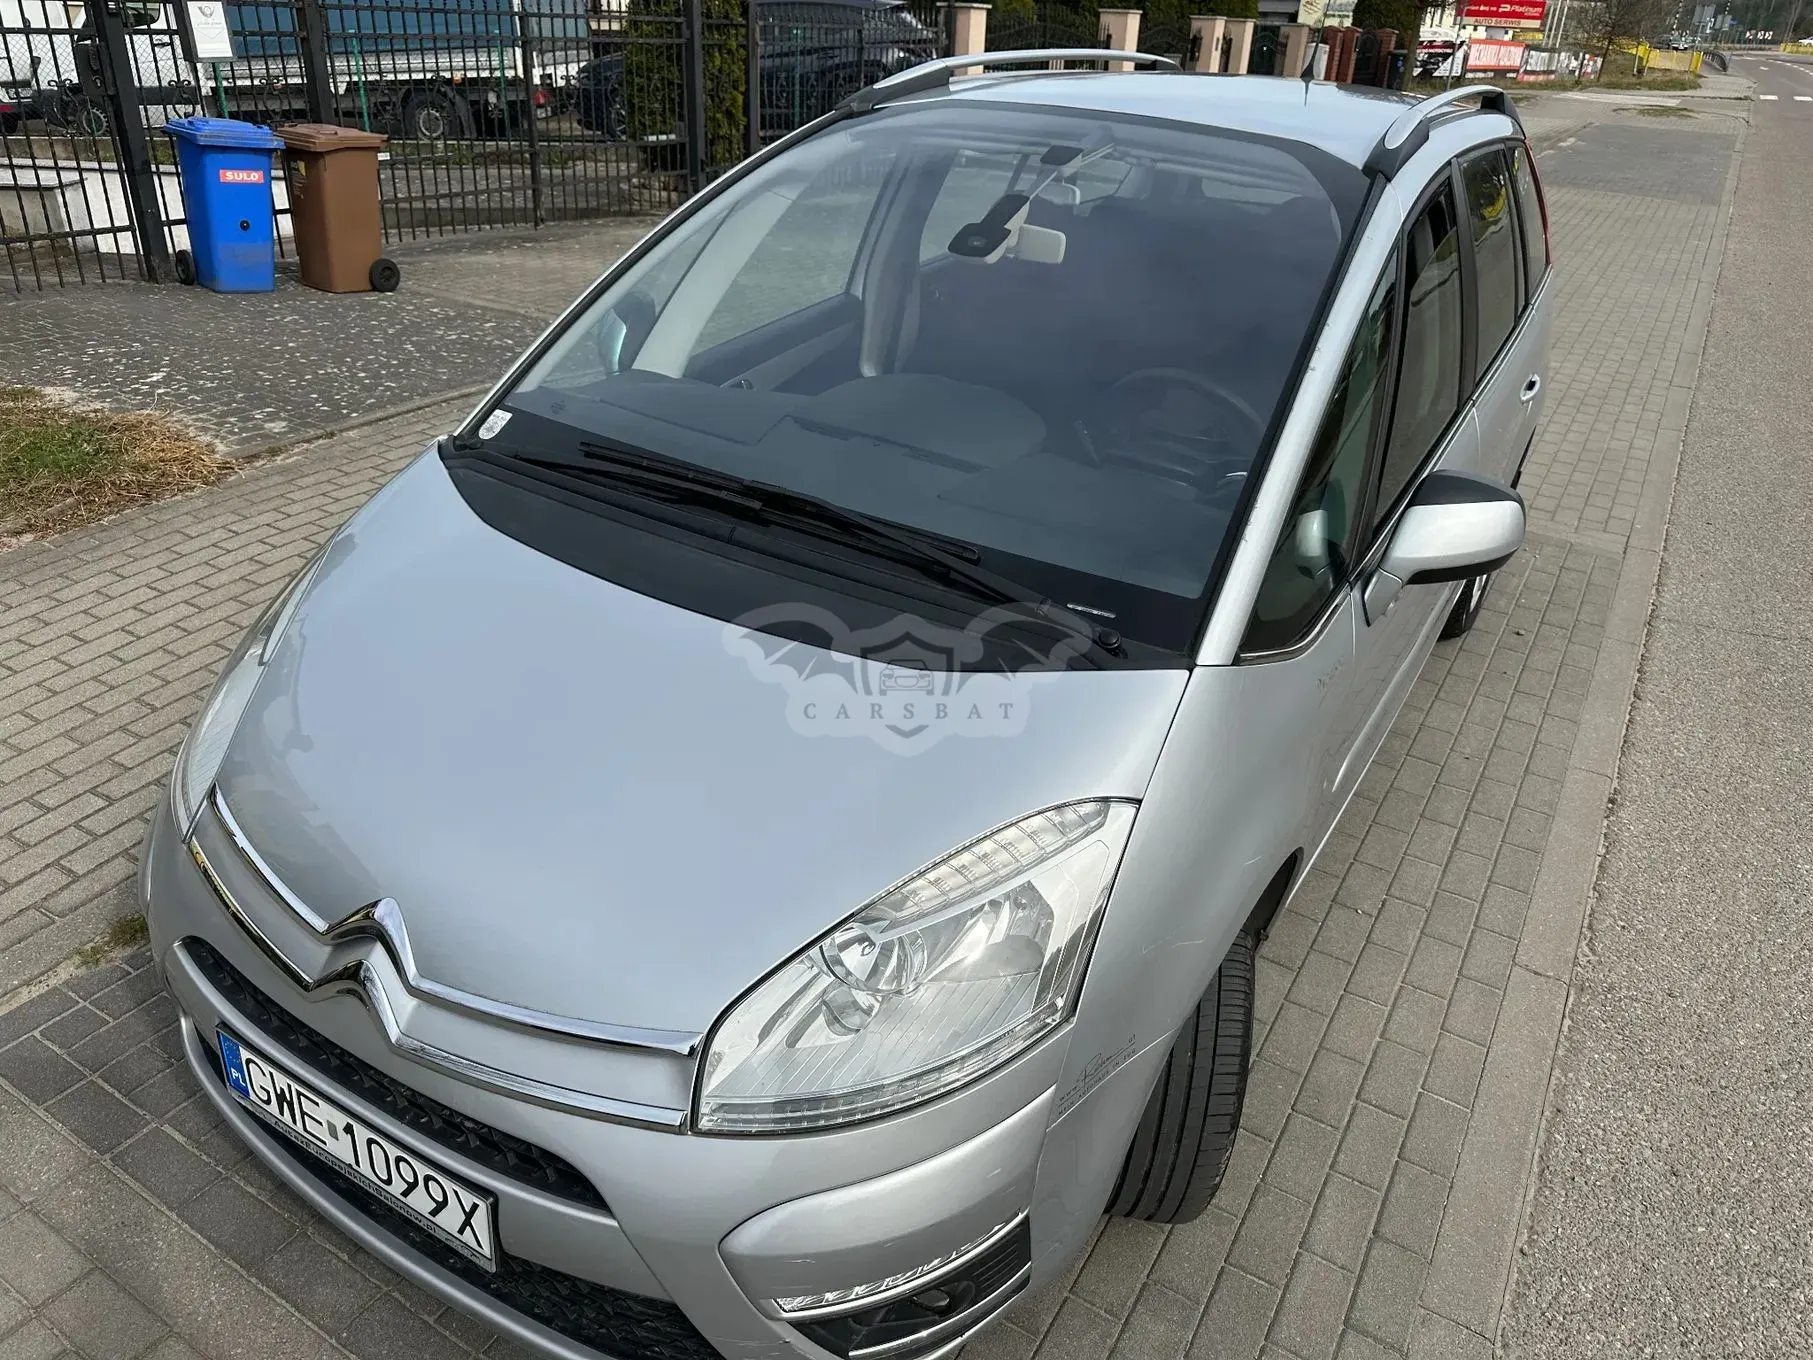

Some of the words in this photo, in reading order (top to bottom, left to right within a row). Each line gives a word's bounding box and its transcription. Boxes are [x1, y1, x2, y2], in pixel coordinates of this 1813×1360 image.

[1510, 5, 1543, 14] Platinum
[1493, 18, 1521, 27] SERWIS
[225, 171, 258, 181] SULO
[231, 1067, 246, 1087] PL
[245, 1057, 327, 1146] GWE
[342, 1121, 484, 1250] 1099X
